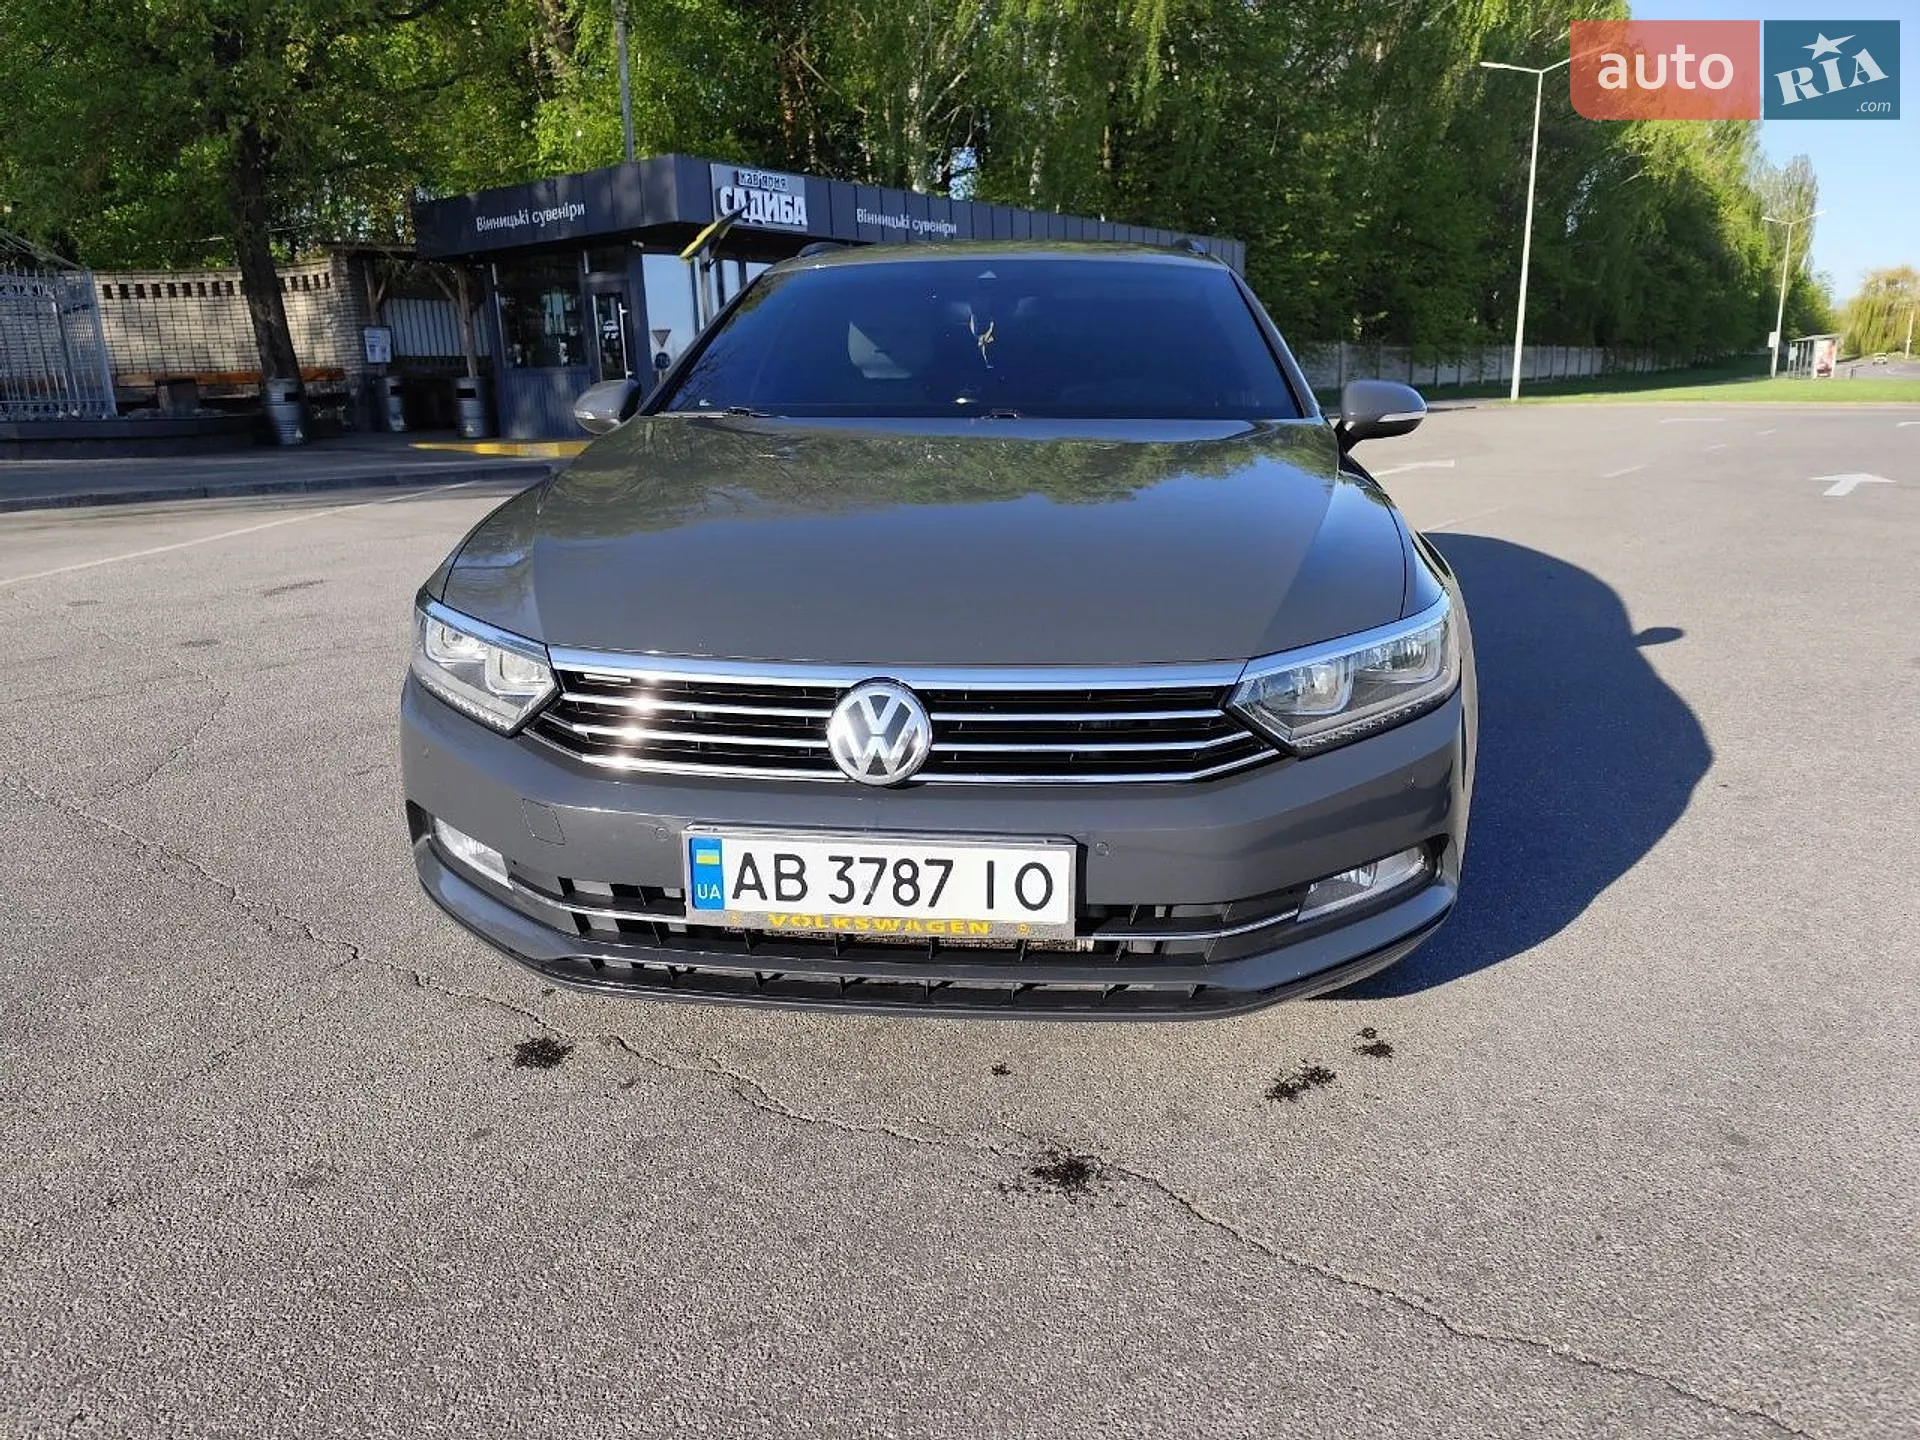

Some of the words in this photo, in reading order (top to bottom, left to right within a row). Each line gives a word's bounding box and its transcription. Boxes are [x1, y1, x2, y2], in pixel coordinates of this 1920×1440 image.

[475, 208, 530, 232] Вінницькі
[532, 201, 585, 228] сувеніри
[720, 186, 807, 226] САДИБА
[856, 208, 910, 230] Вінницькі
[912, 218, 957, 237] сувеніри
[696, 883, 722, 900] UA
[732, 852, 808, 902] AB
[827, 855, 954, 908] 3787
[985, 859, 1053, 911] IO
[768, 913, 991, 936] VOLKSWAGEN
